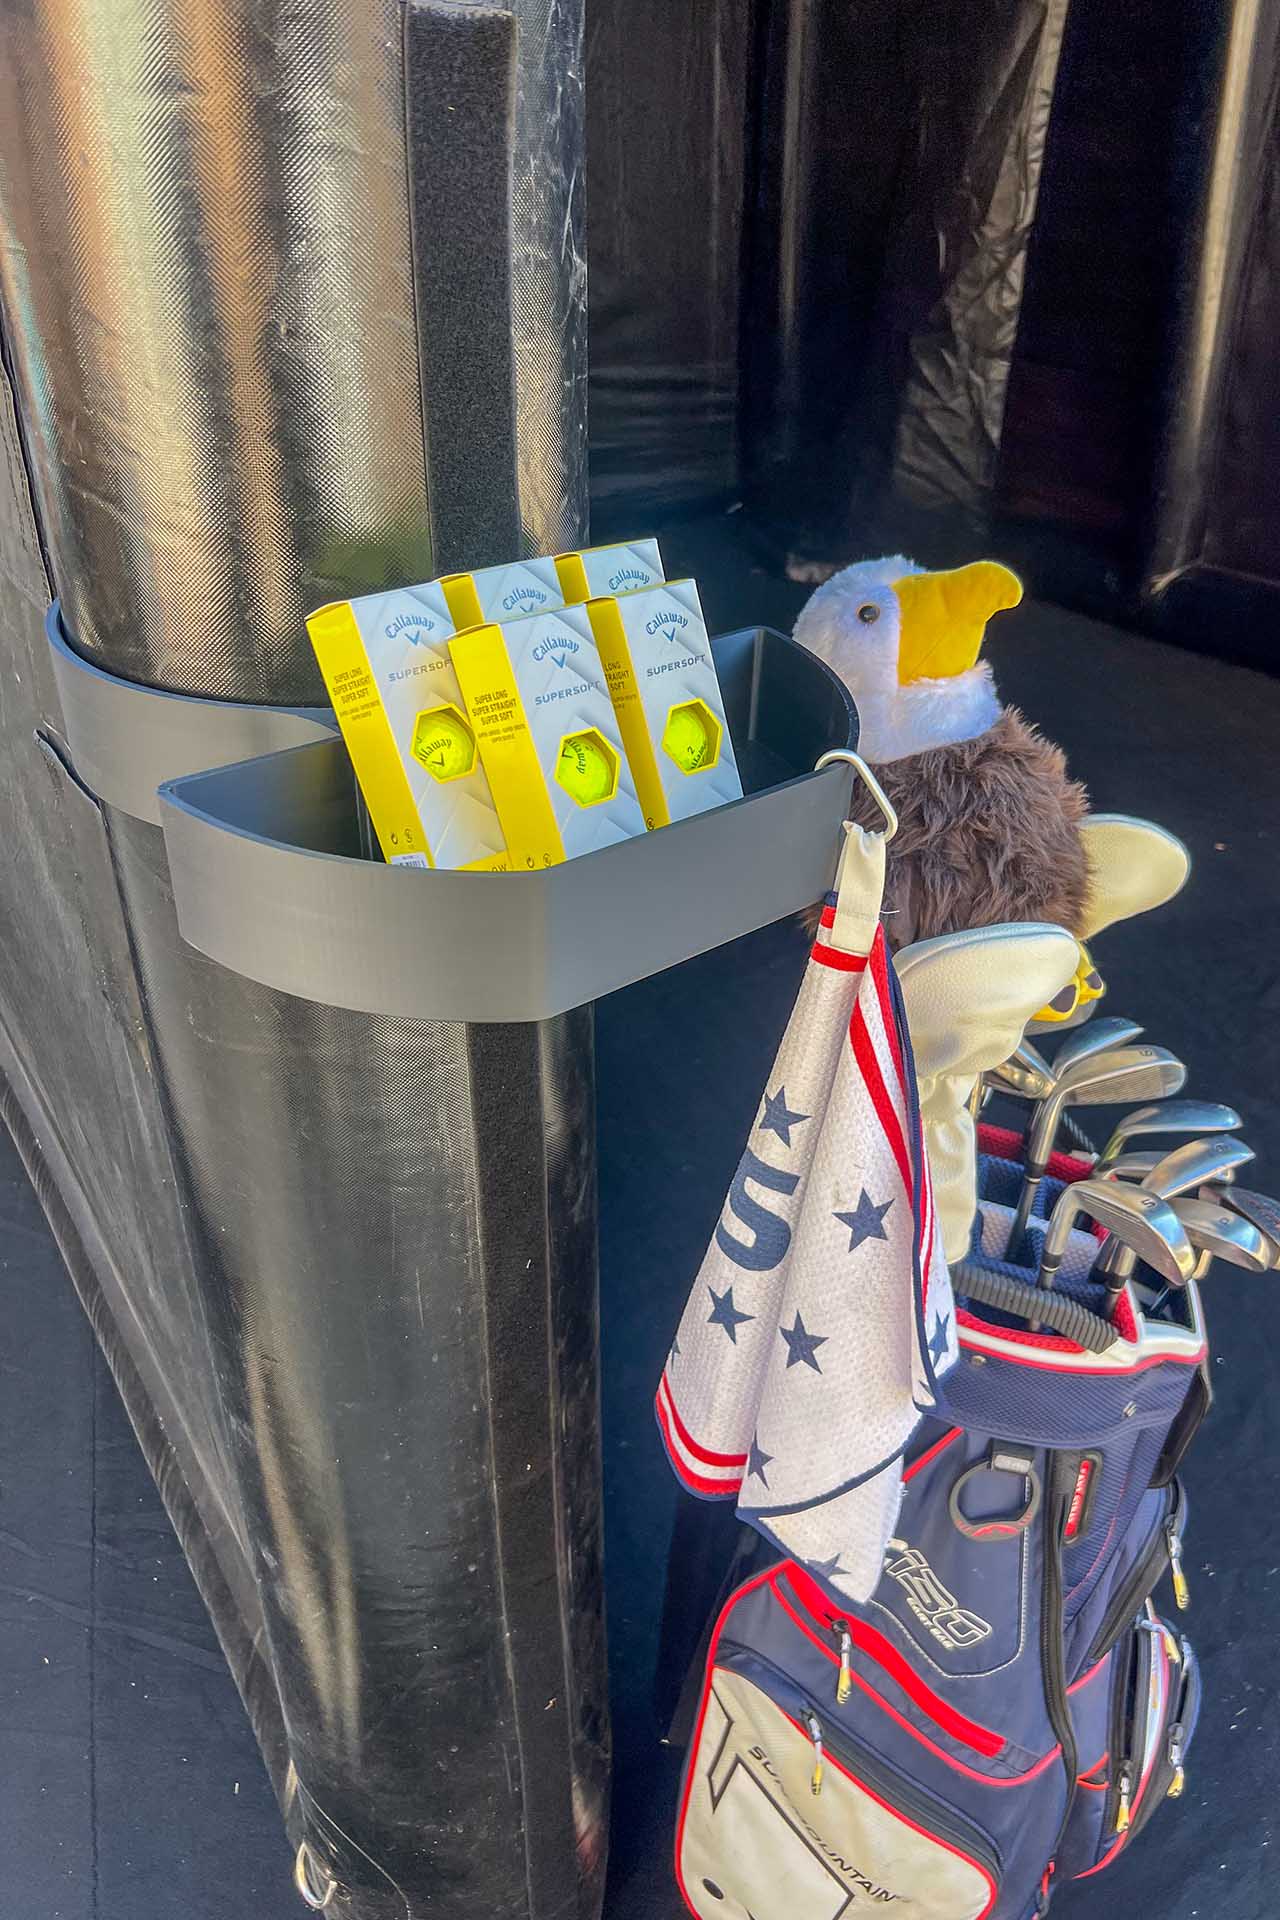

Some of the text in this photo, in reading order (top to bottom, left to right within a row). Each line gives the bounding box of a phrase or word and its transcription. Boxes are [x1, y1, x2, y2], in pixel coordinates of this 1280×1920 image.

[608, 569, 651, 591] Callaway
[502, 586, 548, 610] Callaway
[385, 614, 435, 639] Callaway
[646, 611, 689, 635] Callaway
[532, 637, 580, 661] Callaway
[334, 667, 363, 684] SUPER LONG
[388, 658, 454, 682] SUPERSOF
[605, 670, 630, 681] TRAIGHT
[647, 654, 706, 677] SUPERSOFT
[333, 682, 348, 696] SUPER
[341, 692, 356, 705] SUPER
[474, 689, 508, 705] SUPER LONG
[535, 680, 601, 705] SUPERSOFT
[472, 698, 517, 717] SUPER STRAIGHT
[480, 710, 514, 726] SUPER SOFT
[791, 1804, 897, 1903] OUNTAIN
